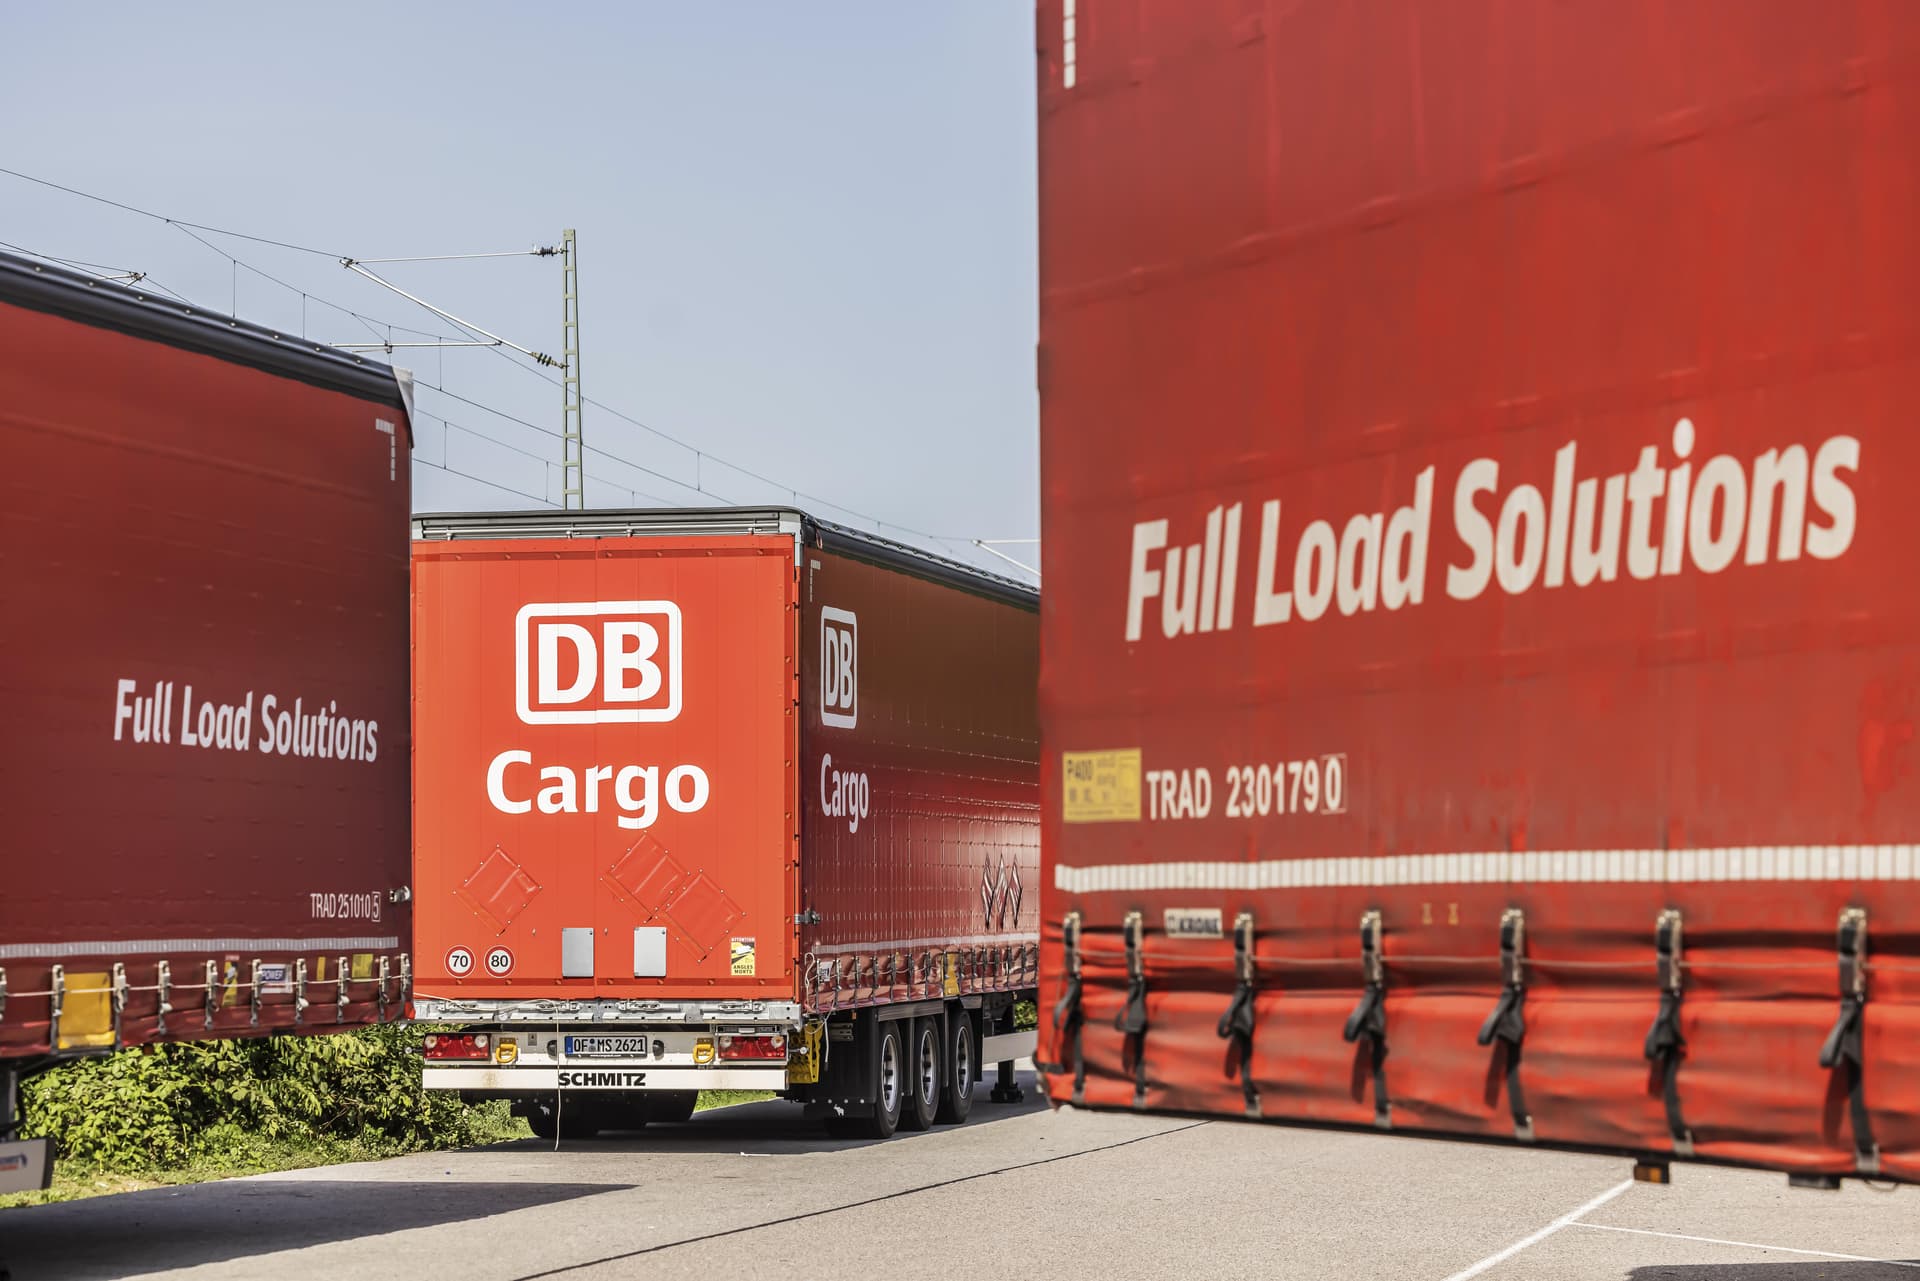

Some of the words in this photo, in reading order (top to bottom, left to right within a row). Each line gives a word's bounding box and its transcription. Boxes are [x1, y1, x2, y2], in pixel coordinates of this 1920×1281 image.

[1124, 501, 1242, 642] Full
[1253, 464, 1434, 627] Load
[1445, 417, 1861, 600] Solutions
[537, 620, 663, 705] DB
[825, 626, 854, 710] DB
[113, 678, 173, 744] Full
[180, 685, 254, 751] Load
[258, 694, 378, 762] Solutions
[486, 749, 710, 830] Cargo
[820, 753, 869, 834] Cargo
[1145, 768, 1212, 821] TRAD
[310, 892, 337, 918] TRAD
[451, 954, 469, 968] 70
[490, 954, 509, 968] 80
[573, 1038, 588, 1052] OF
[596, 1038, 613, 1052] MS
[614, 1038, 645, 1052] 2621
[558, 1072, 647, 1087] SCHMITZ
